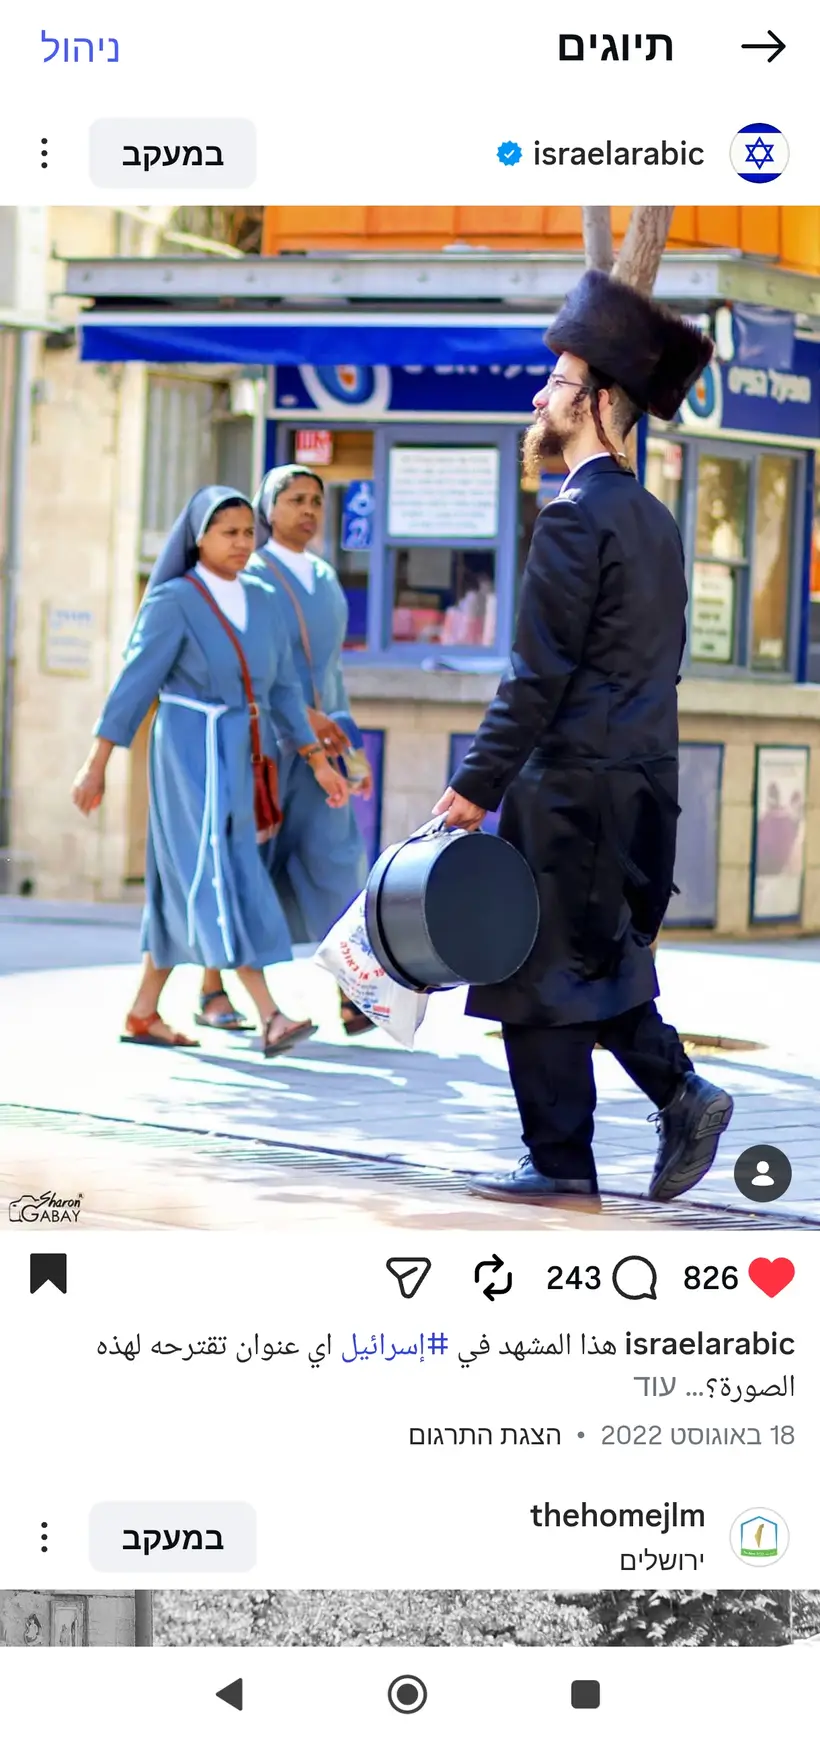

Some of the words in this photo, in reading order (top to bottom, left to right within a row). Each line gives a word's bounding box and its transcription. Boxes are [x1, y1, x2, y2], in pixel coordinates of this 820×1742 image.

[41, 30, 119, 63] ניהול
[559, 33, 673, 62] תיוגים
[123, 145, 225, 172] במעקב
[534, 140, 705, 166] israelarabic
[546, 1265, 602, 1291] 243
[683, 1264, 739, 1291] 826
[96, 1332, 141, 1362] لهذه
[150, 1335, 228, 1362] تقترحه
[235, 1332, 300, 1364] عنوان
[307, 1332, 332, 1369] اي
[341, 1331, 449, 1364] #إسرائيل
[457, 1332, 491, 1369] في
[499, 1332, 571, 1362] المشهد
[581, 1333, 616, 1356] هذا
[625, 1330, 796, 1356] israelarabic
[633, 1376, 677, 1398] עוד
[409, 1427, 493, 1446] התרגום
[500, 1427, 561, 1446] הצגת
[601, 1424, 663, 1446] 2022
[670, 1427, 762, 1446] באוגוסט
[769, 1424, 795, 1445] 18
[529, 1501, 705, 1534] thehomejlm
[123, 1529, 225, 1556] במעקב
[620, 1547, 704, 1571] ירושלים
